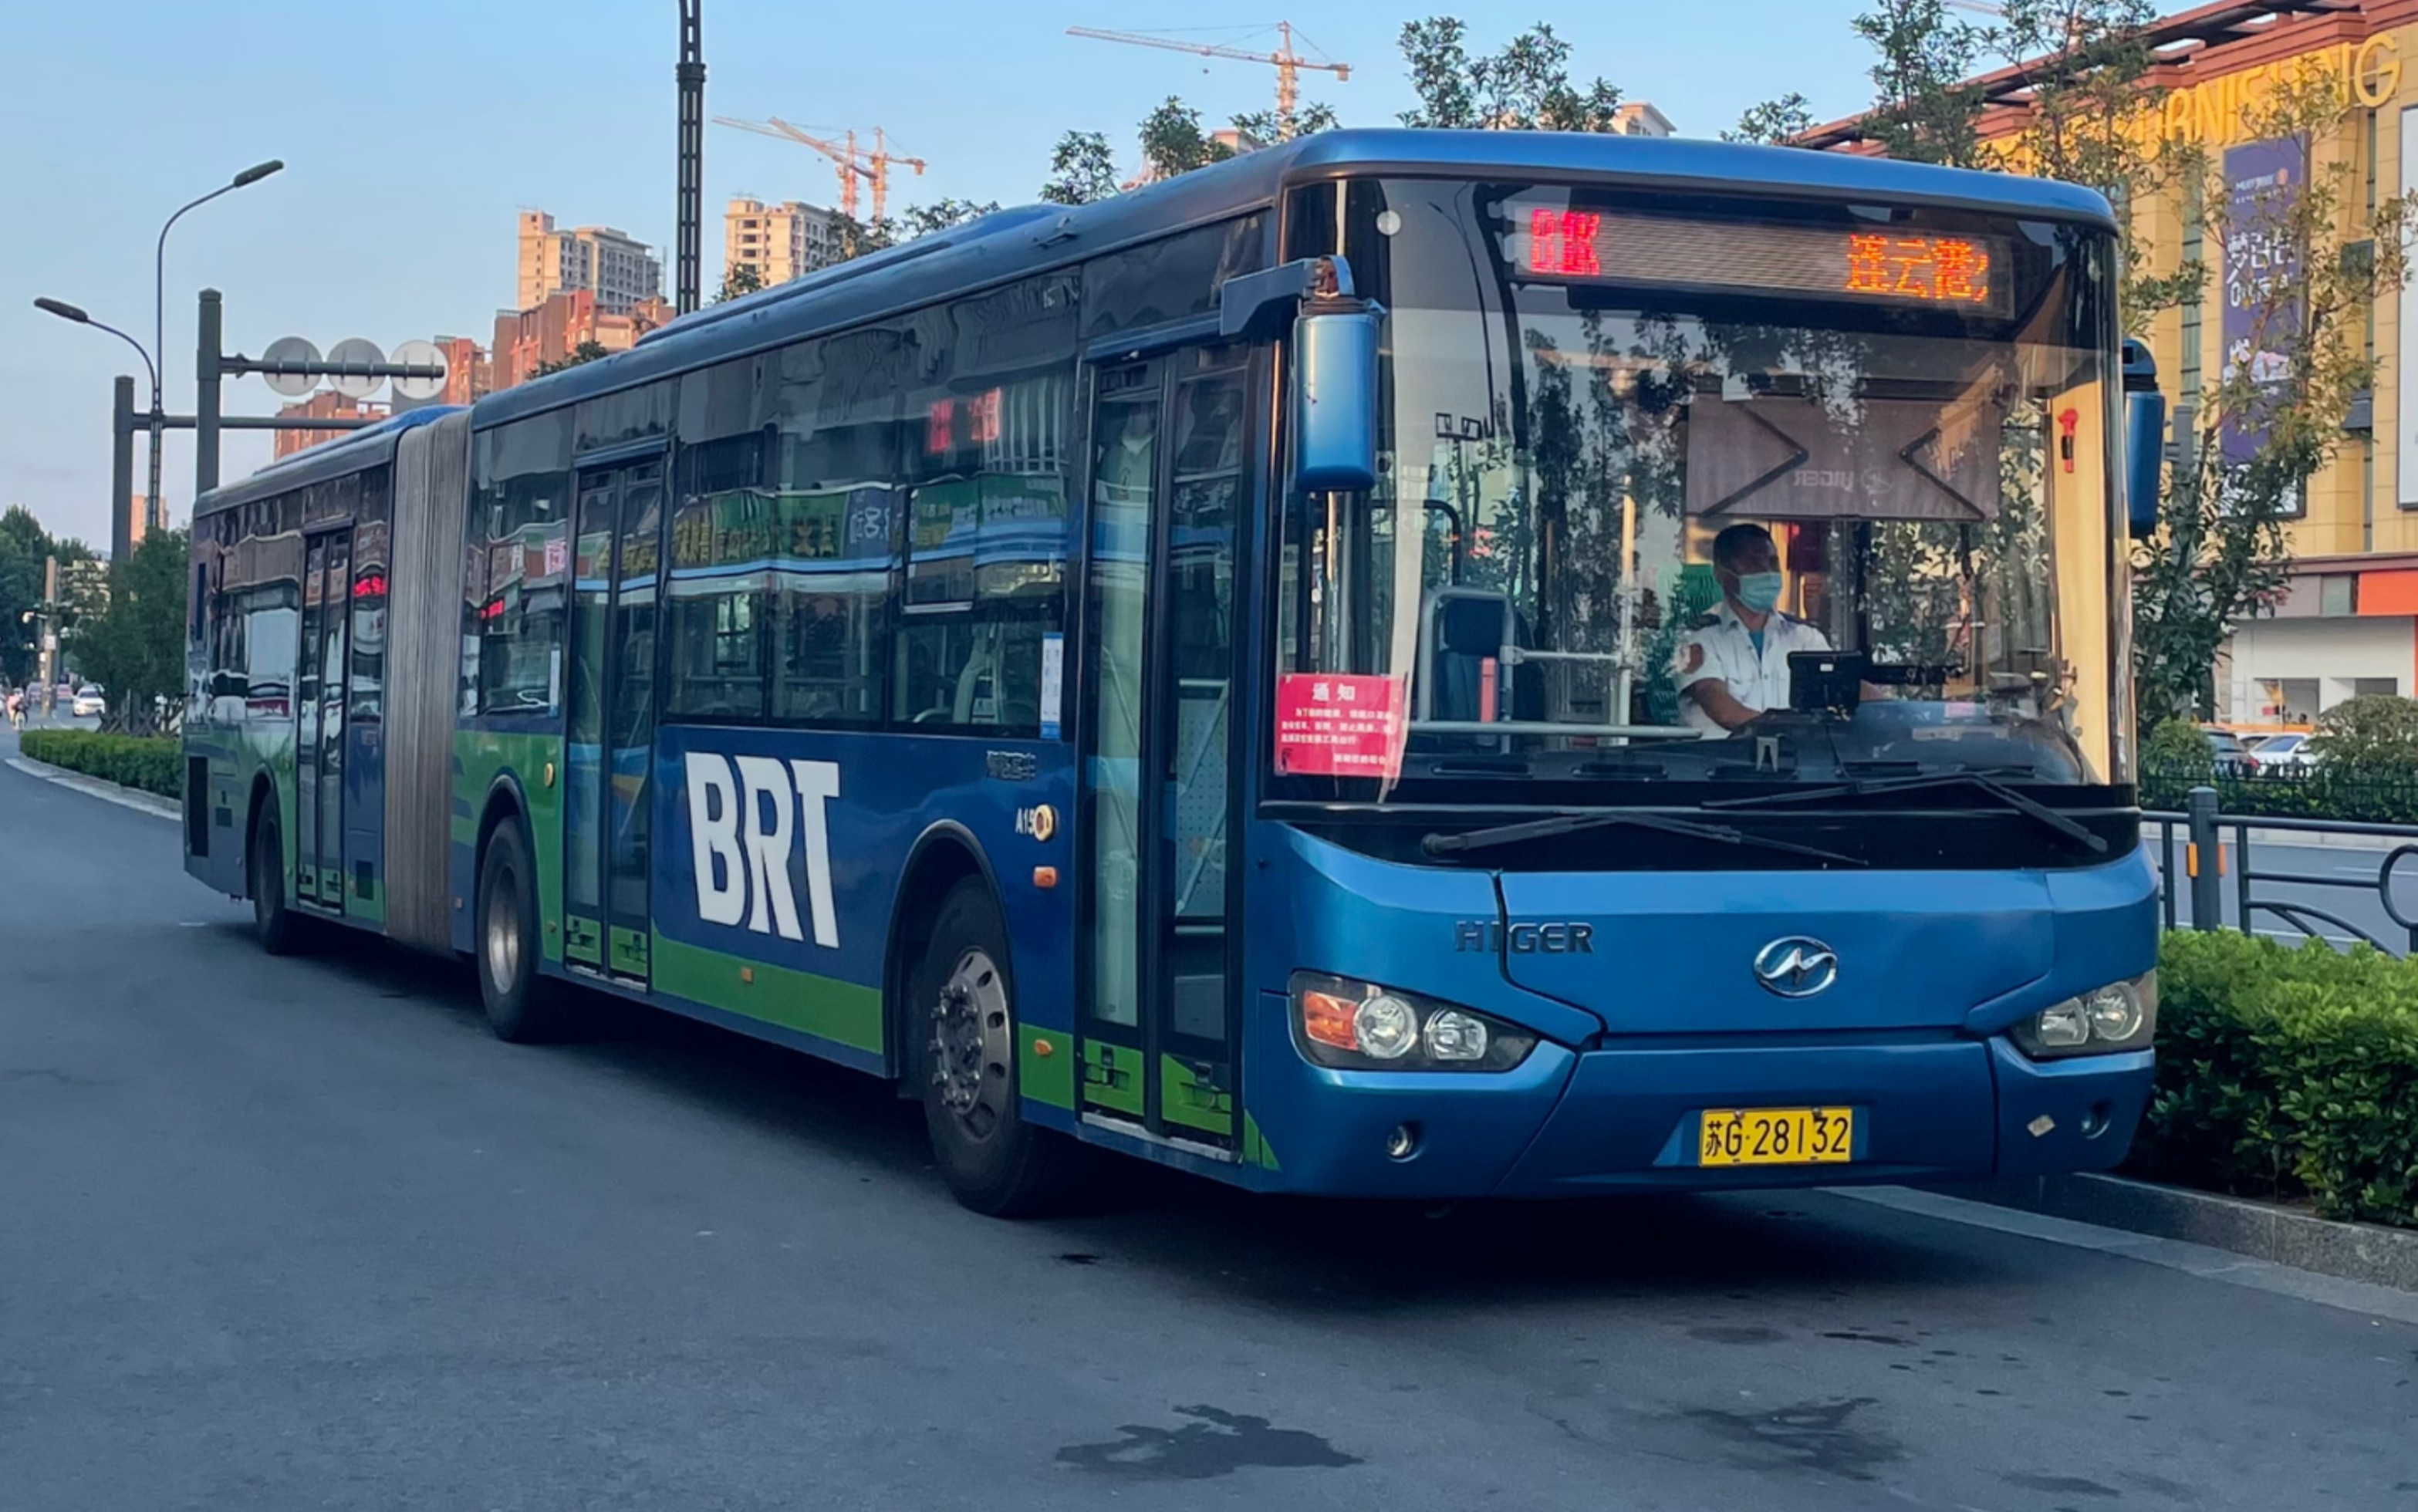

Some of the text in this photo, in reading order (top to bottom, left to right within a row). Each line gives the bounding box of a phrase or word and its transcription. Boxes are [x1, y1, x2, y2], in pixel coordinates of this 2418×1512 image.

[1312, 683, 1356, 701] 通知
[685, 751, 840, 949] BRT
[1455, 920, 1594, 953] HIGER
